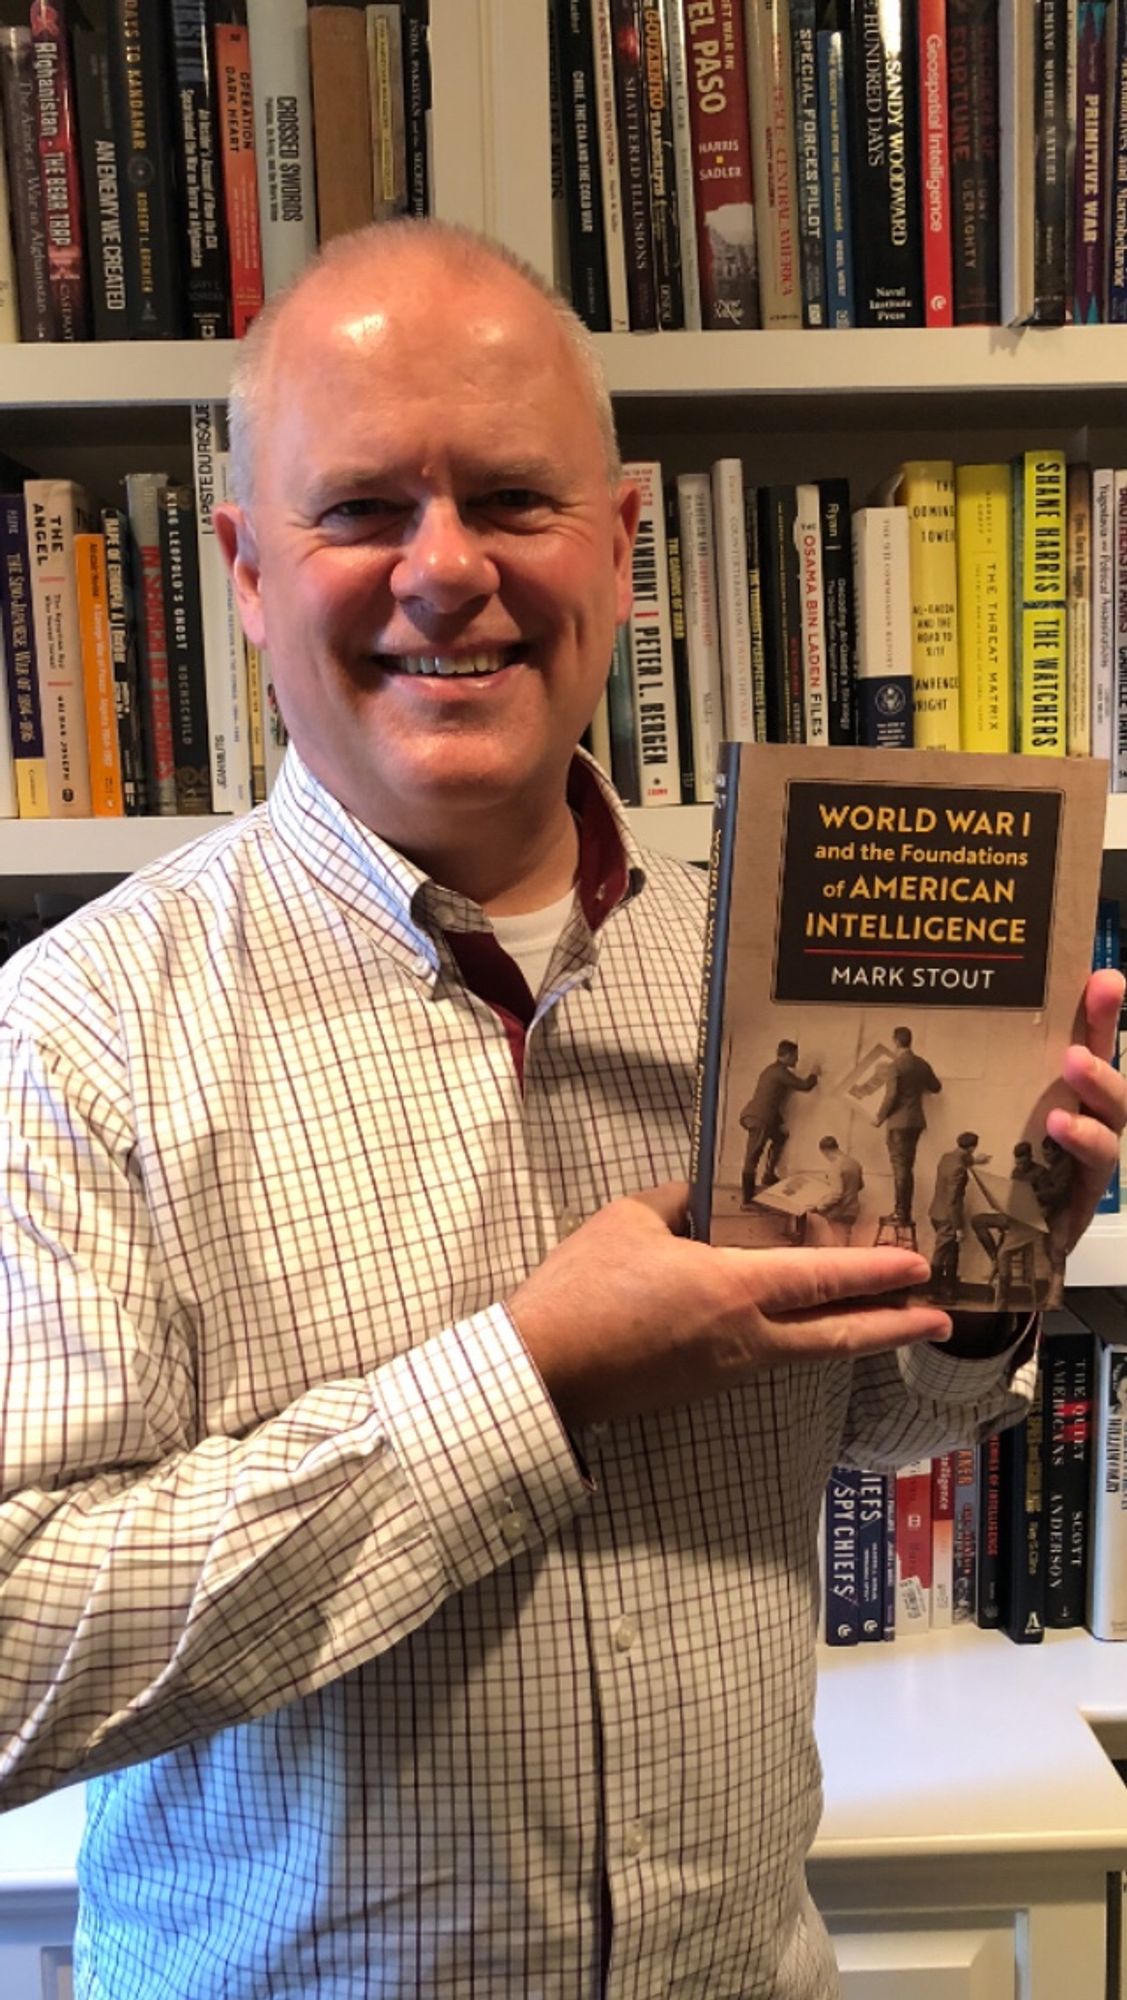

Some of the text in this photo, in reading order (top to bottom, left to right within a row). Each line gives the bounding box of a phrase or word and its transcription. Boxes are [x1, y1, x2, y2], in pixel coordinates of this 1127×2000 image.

[645, 9, 665, 110] GOUZENKO
[688, 0, 727, 113] EL PASO
[723, 21, 735, 70] WAR IN
[799, 28, 816, 103] SPECIAL
[34, 42, 59, 137] Afghanistan
[127, 69, 146, 150] KANDAHAR
[225, 66, 241, 153] DARK HEART
[239, 72, 253, 150] OPERATION
[574, 103, 586, 121] THE
[864, 13, 884, 167] HUNDRED DAYS
[950, 25, 971, 164] FORTUNE
[1044, 60, 1057, 186] MOTHER NATURE
[45, 152, 64, 175] THE
[95, 140, 116, 163] AN
[276, 96, 303, 222] CROSSED SWORDS
[410, 59, 424, 195] PAKISTAN SECRET
[576, 122, 588, 141] CIA
[577, 142, 589, 164] AND
[603, 101, 615, 166] REVOLUTION
[624, 77, 640, 178] SHATTERED
[650, 110, 665, 196] TRANSCRIPTS
[699, 139, 740, 153] HARRIS
[803, 108, 819, 181] FORCES
[885, 60, 908, 246] SANDY WOODWARD
[925, 34, 944, 232] Geospatial Intelligence
[27, 177, 42, 208] War
[97, 165, 119, 218] ENEMY
[578, 164, 590, 182] THE
[580, 183, 591, 208] COLD
[699, 166, 743, 181] SADLER
[1083, 94, 1099, 243] PRIMITIVE WAR
[49, 213, 71, 247] TRAP
[101, 219, 121, 243] WE
[136, 192, 149, 234] ROBERT
[581, 210, 593, 233] WAR
[631, 183, 647, 270] ILLUSIONS
[777, 147, 794, 297] CENTRAL AMERICA
[806, 184, 821, 239] PILOT
[963, 180, 976, 268] GERAGHTY
[1113, 187, 1127, 288] Macrobehavior
[103, 245, 126, 311] CREATED
[876, 287, 907, 298] Naval
[877, 311, 906, 321] Press
[32, 502, 49, 567] ANGEL
[50, 515, 64, 553] THE
[826, 503, 840, 538] Ryan
[1034, 462, 1060, 593] SHANE HARRIS
[1096, 484, 1110, 538] Yugoslavia
[142, 545, 158, 568] IN
[166, 492, 187, 650] KING LEOPOLD'S GHOST
[632, 519, 658, 603] MANHUNT
[1099, 554, 1111, 595] Political
[6, 553, 22, 574] THE
[14, 650, 30, 674] WAR
[803, 535, 822, 737] OSAMA BIN LADEN FILES
[985, 563, 999, 732] THE THREAT MATRIX
[1100, 597, 1112, 670] Assassinations
[178, 665, 192, 745] HOCHSCHILD
[636, 626, 668, 766] PETER L. BERGEN
[1032, 618, 1060, 748] THE WATCHERS
[814, 842, 1029, 867] and the Foundations
[818, 803, 1032, 837] WORLD WAR I
[822, 874, 1016, 904] of AMERICAN
[804, 911, 1027, 944] INTELLIGENCE
[830, 964, 995, 990] MARK STOUT
[1051, 1360, 1066, 1466] AMERICANS
[1072, 1358, 1088, 1462] THE QUIET
[832, 1487, 856, 1597] SPY CHIEFS
[987, 1489, 1001, 1557] INTELLIGENCE
[1048, 1491, 1064, 1589] ANDERSON
[1070, 1511, 1084, 1568] SCOTT
